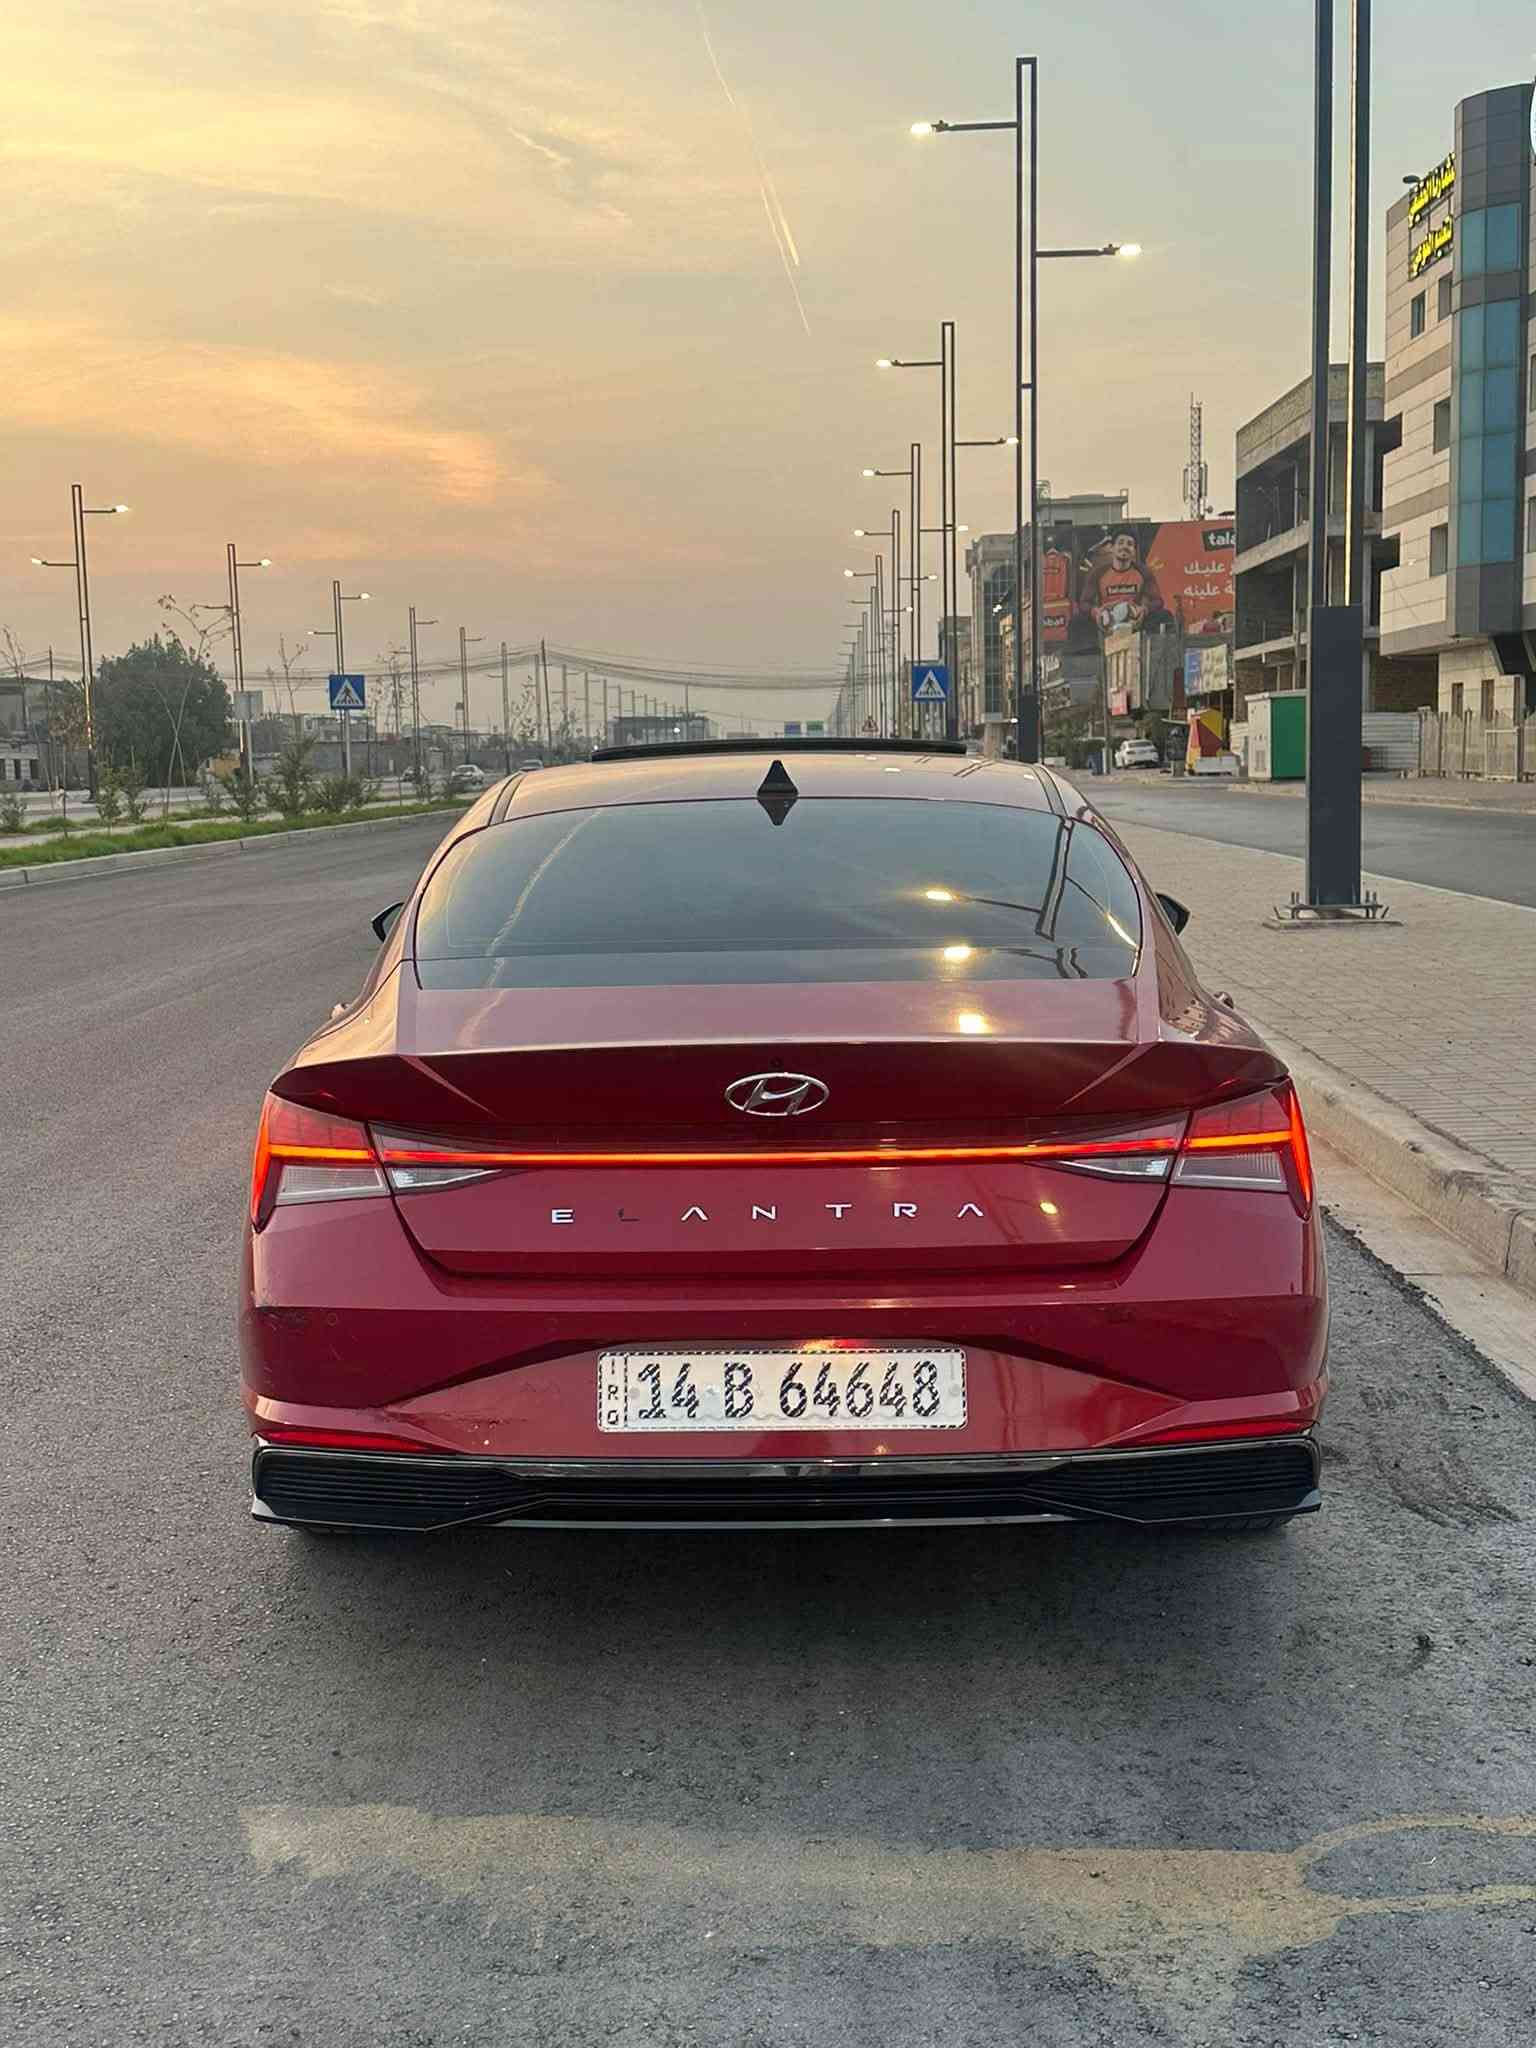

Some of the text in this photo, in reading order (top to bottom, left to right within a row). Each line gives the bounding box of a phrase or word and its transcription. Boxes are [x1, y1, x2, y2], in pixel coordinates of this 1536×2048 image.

[551, 1202, 984, 1224] ELANTRA
[637, 1360, 940, 1418] 14 B 64648
